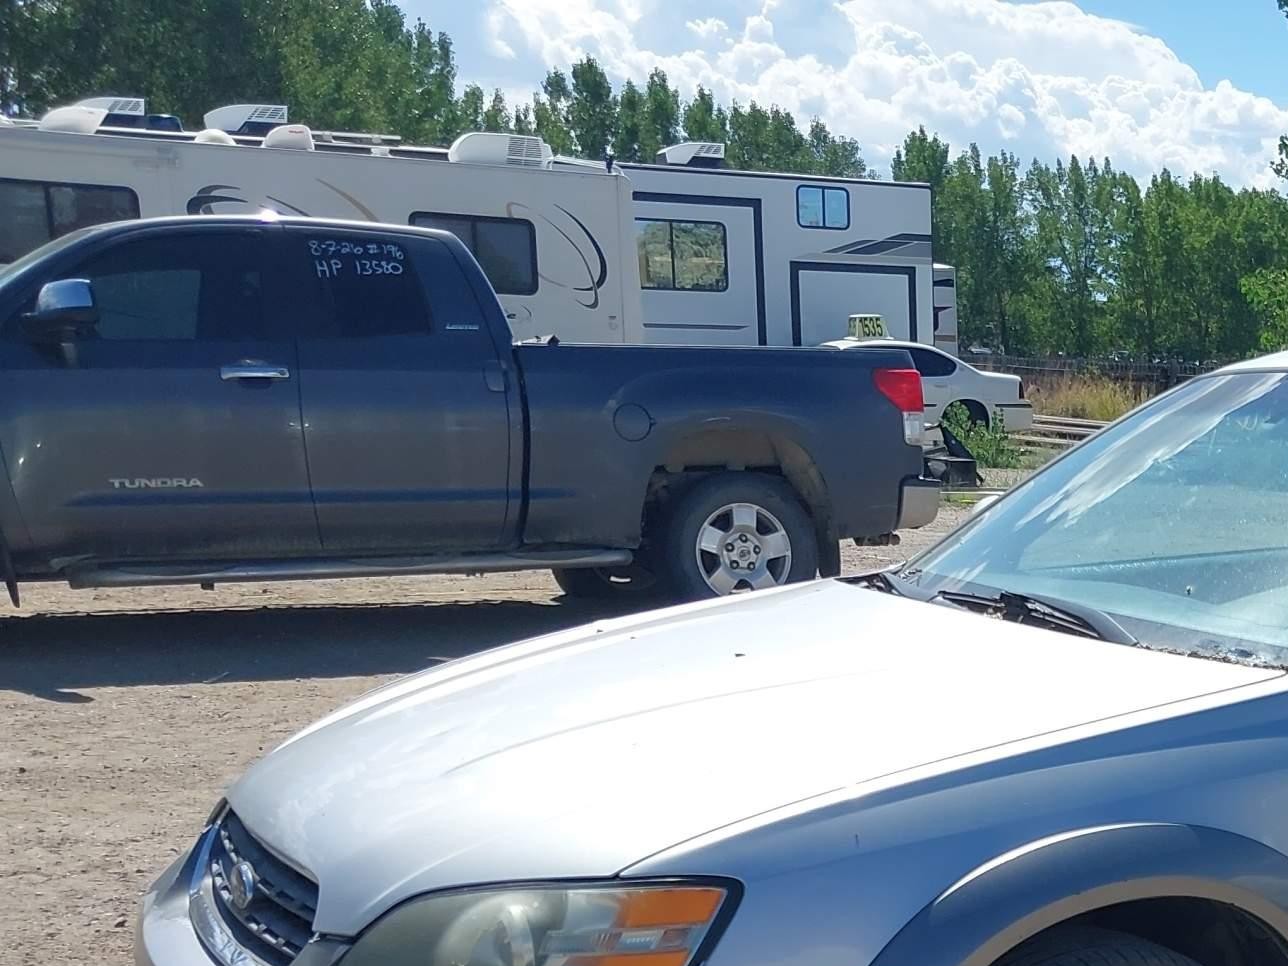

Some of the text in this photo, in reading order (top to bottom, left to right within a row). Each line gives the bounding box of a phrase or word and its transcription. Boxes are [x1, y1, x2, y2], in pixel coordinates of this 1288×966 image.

[315, 259, 403, 278] HP 13580
[859, 317, 883, 337] 1535
[109, 478, 204, 489] TUNDRA
